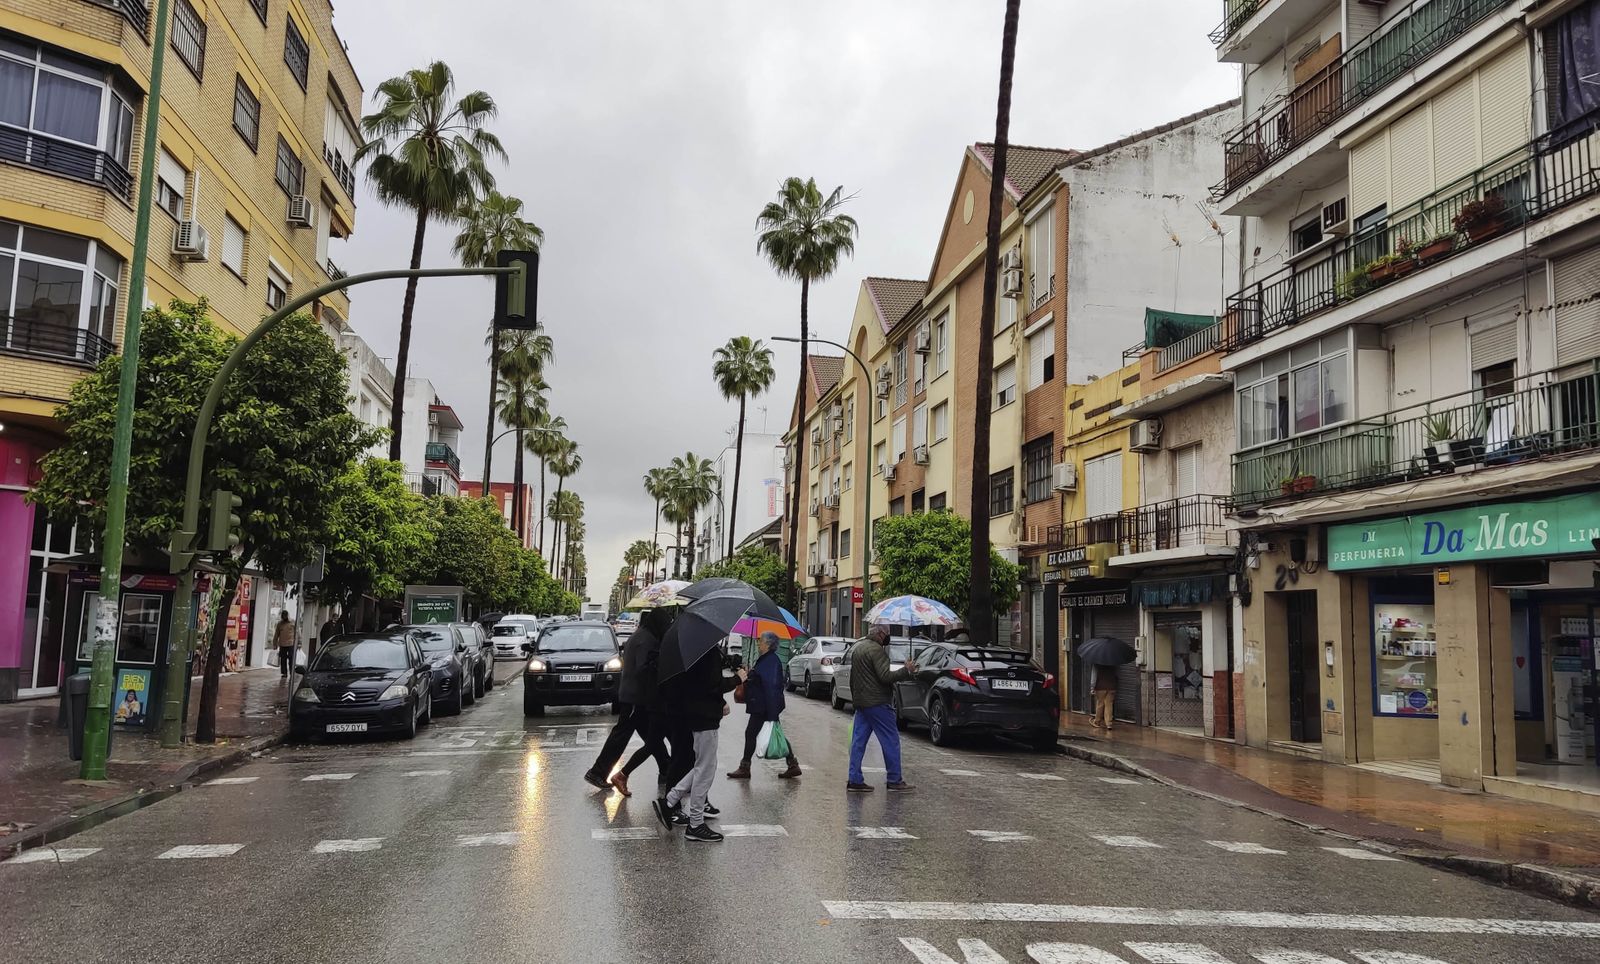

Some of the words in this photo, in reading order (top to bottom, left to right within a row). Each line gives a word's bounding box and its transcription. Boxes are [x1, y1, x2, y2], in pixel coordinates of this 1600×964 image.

[1334, 546, 1405, 562] PERFUMERIA
[1420, 520, 1465, 556] Da
[1474, 512, 1549, 552] Mas
[1048, 553, 1057, 565] EL
[1058, 548, 1085, 564] CARMEN
[1044, 571, 1061, 582] REGALOS
[1078, 596, 1084, 606] EL
[1084, 595, 1104, 606] CARMEN
[123, 674, 146, 682] BIEN
[120, 682, 145, 691] JUGADO
